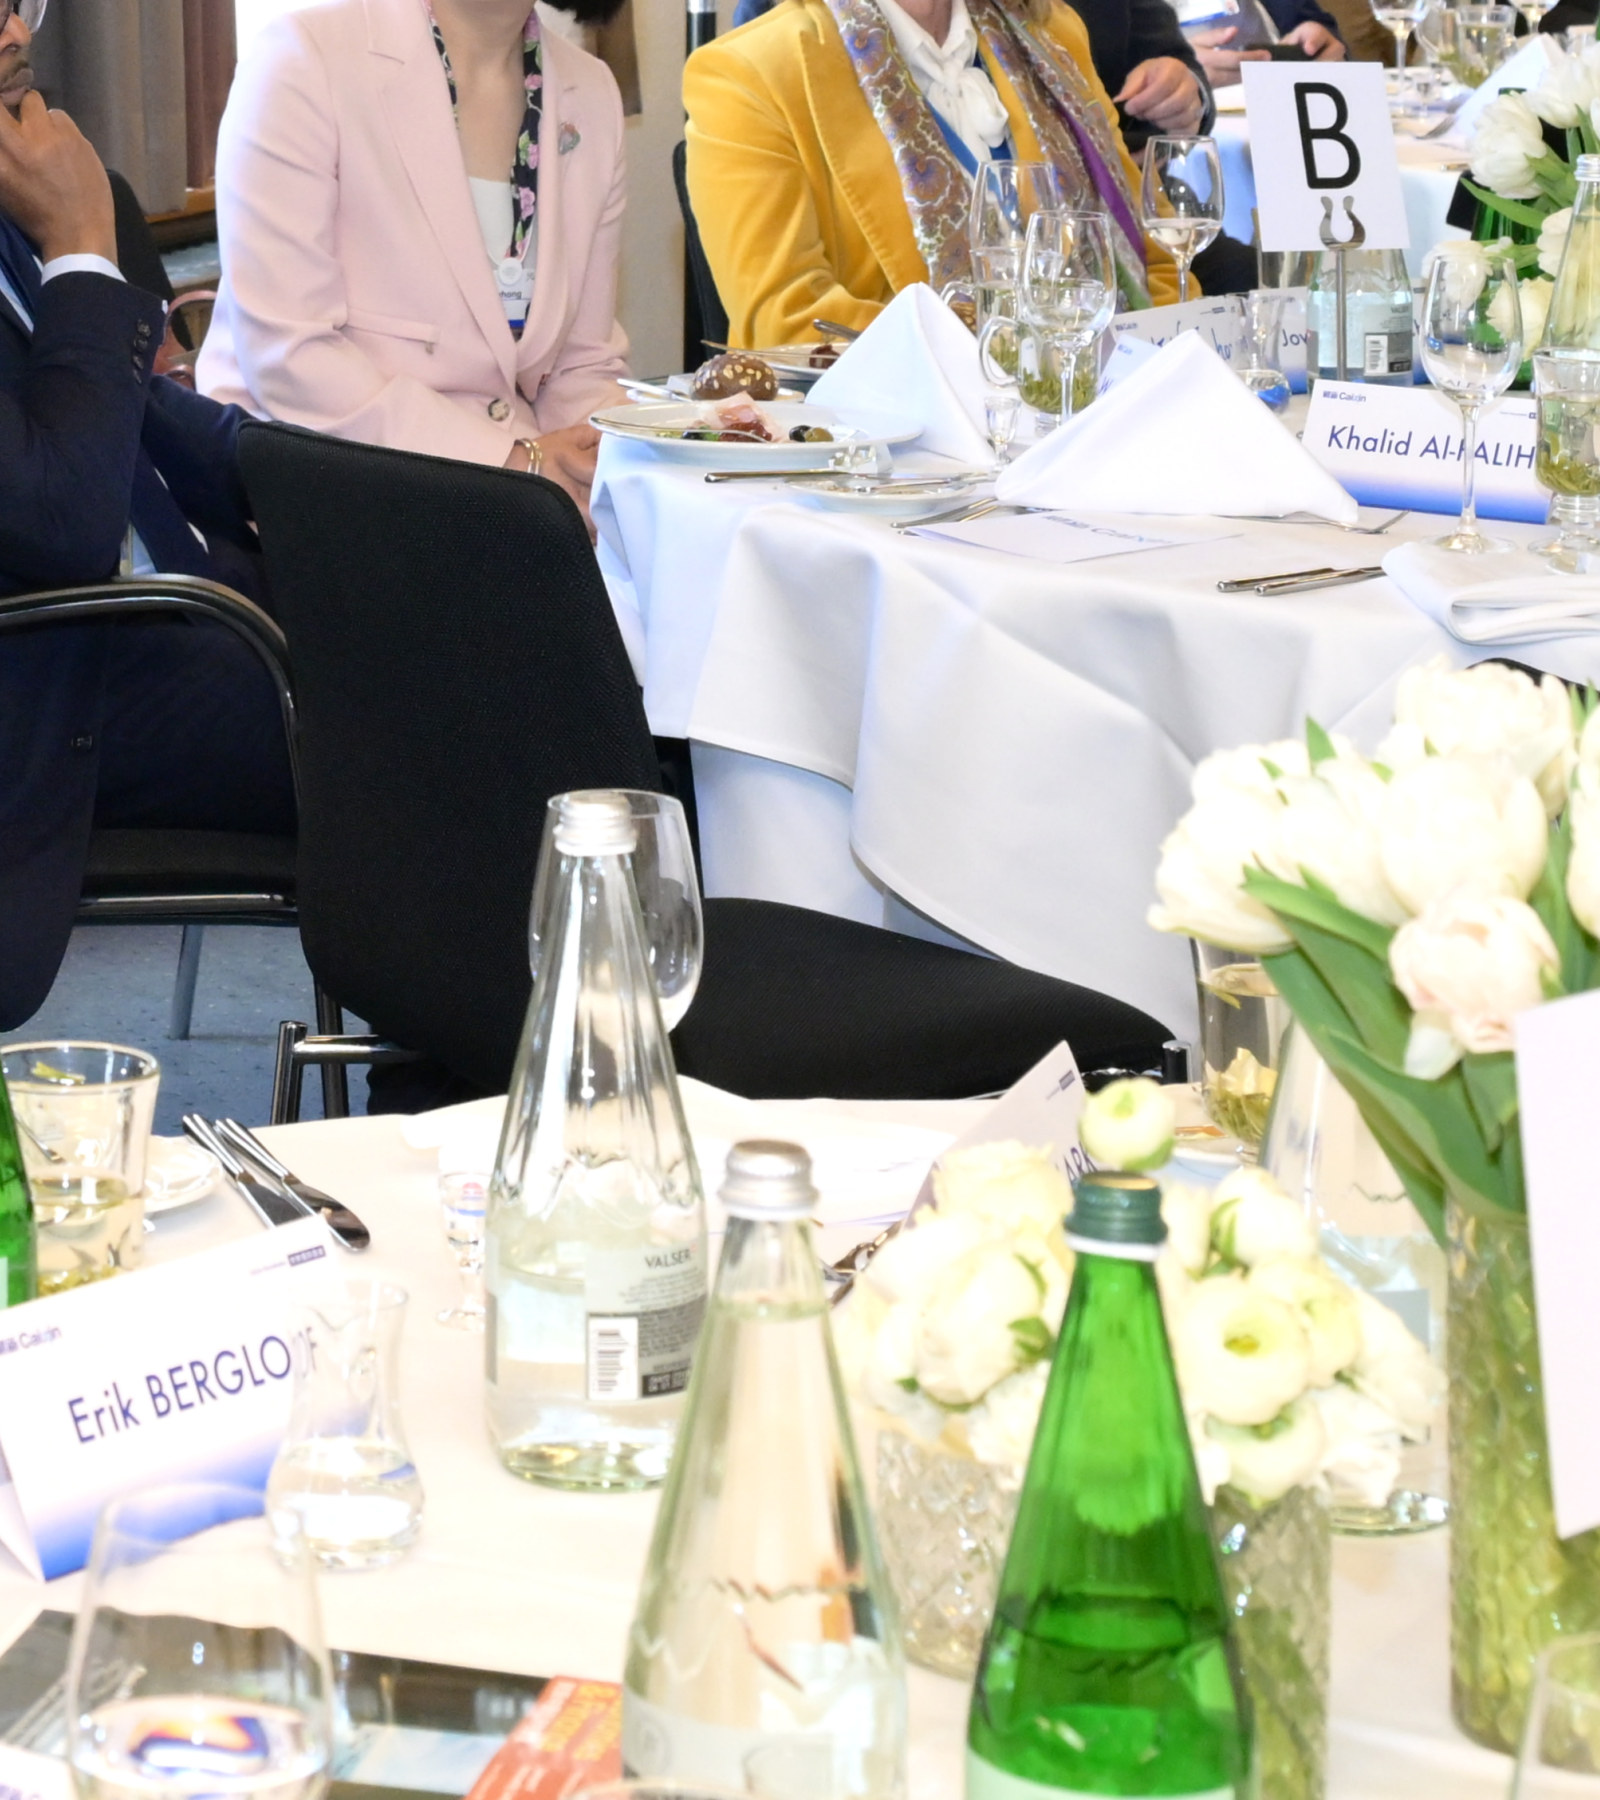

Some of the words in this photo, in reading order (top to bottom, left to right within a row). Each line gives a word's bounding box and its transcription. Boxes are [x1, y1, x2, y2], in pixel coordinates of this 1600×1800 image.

[1294, 81, 1362, 190] B
[1327, 425, 1412, 456] Khalid
[644, 1248, 691, 1269] VALSER
[67, 1381, 140, 1444] Erik
